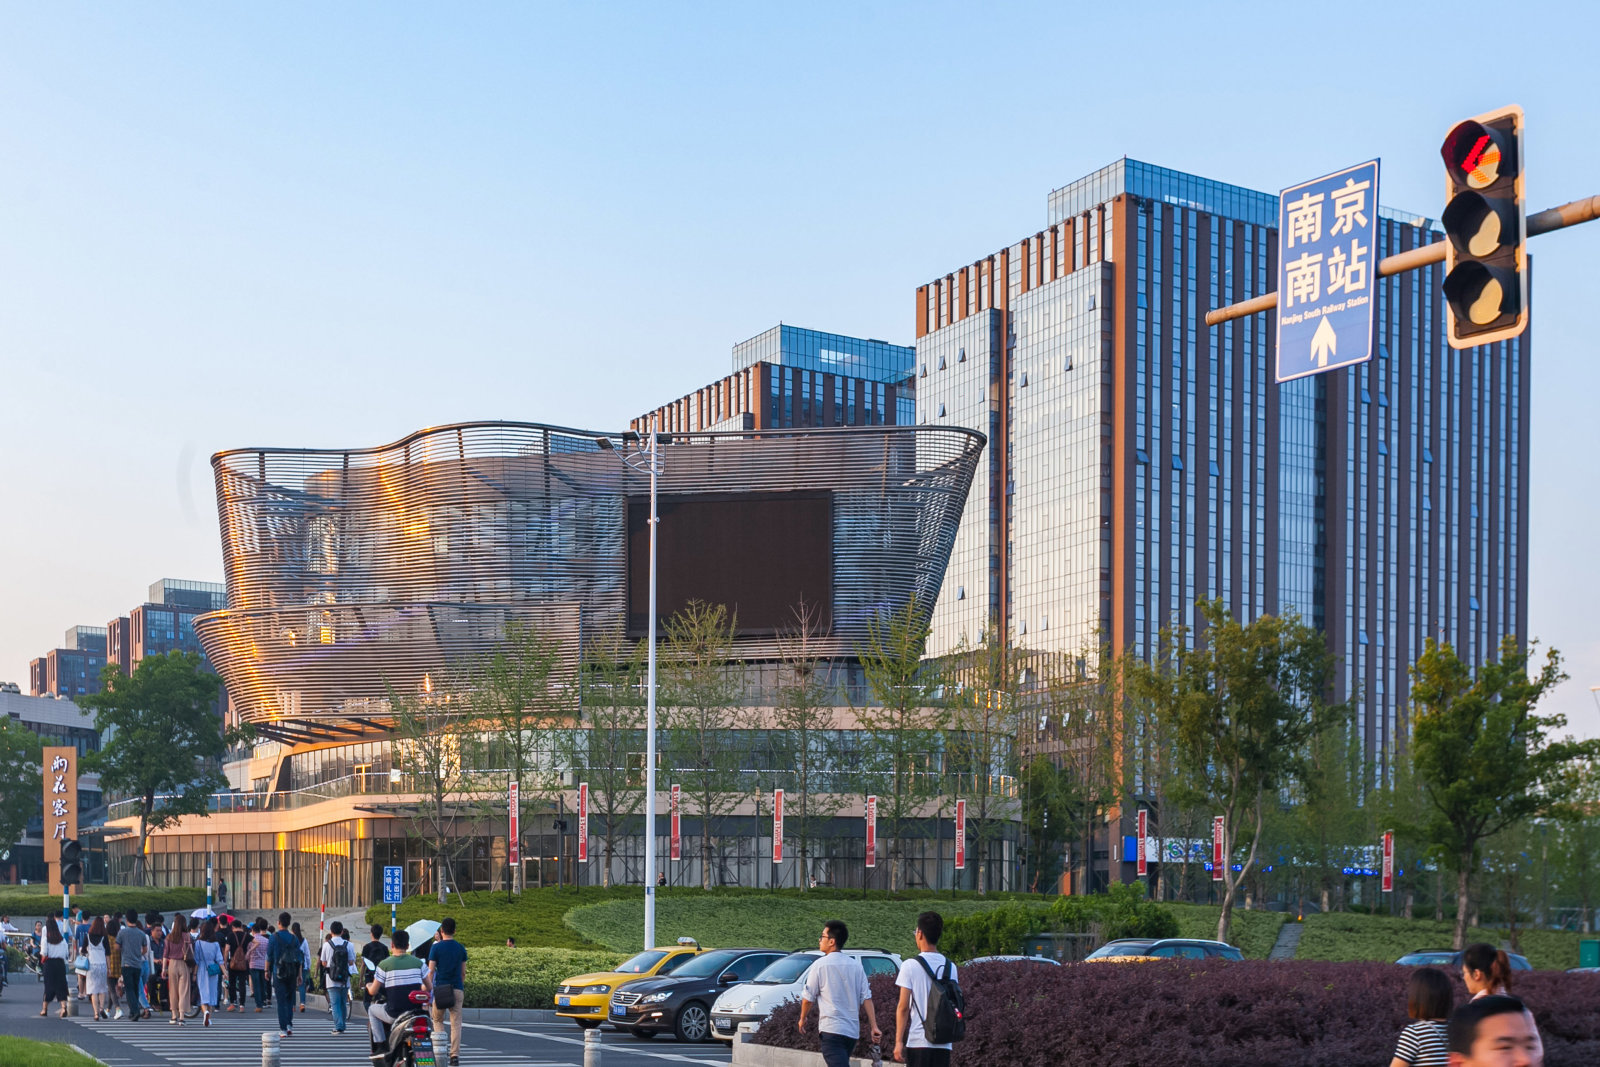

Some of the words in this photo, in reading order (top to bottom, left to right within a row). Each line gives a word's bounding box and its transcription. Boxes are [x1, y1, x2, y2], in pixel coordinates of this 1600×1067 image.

[1287, 178, 1370, 249] 南京
[1286, 238, 1368, 308] 南站
[1281, 313, 1303, 326] Nanjing
[1303, 308, 1321, 320] South
[1322, 302, 1346, 315] Railway
[1347, 296, 1369, 308] Station
[51, 755, 69, 840] 雨花客厅
